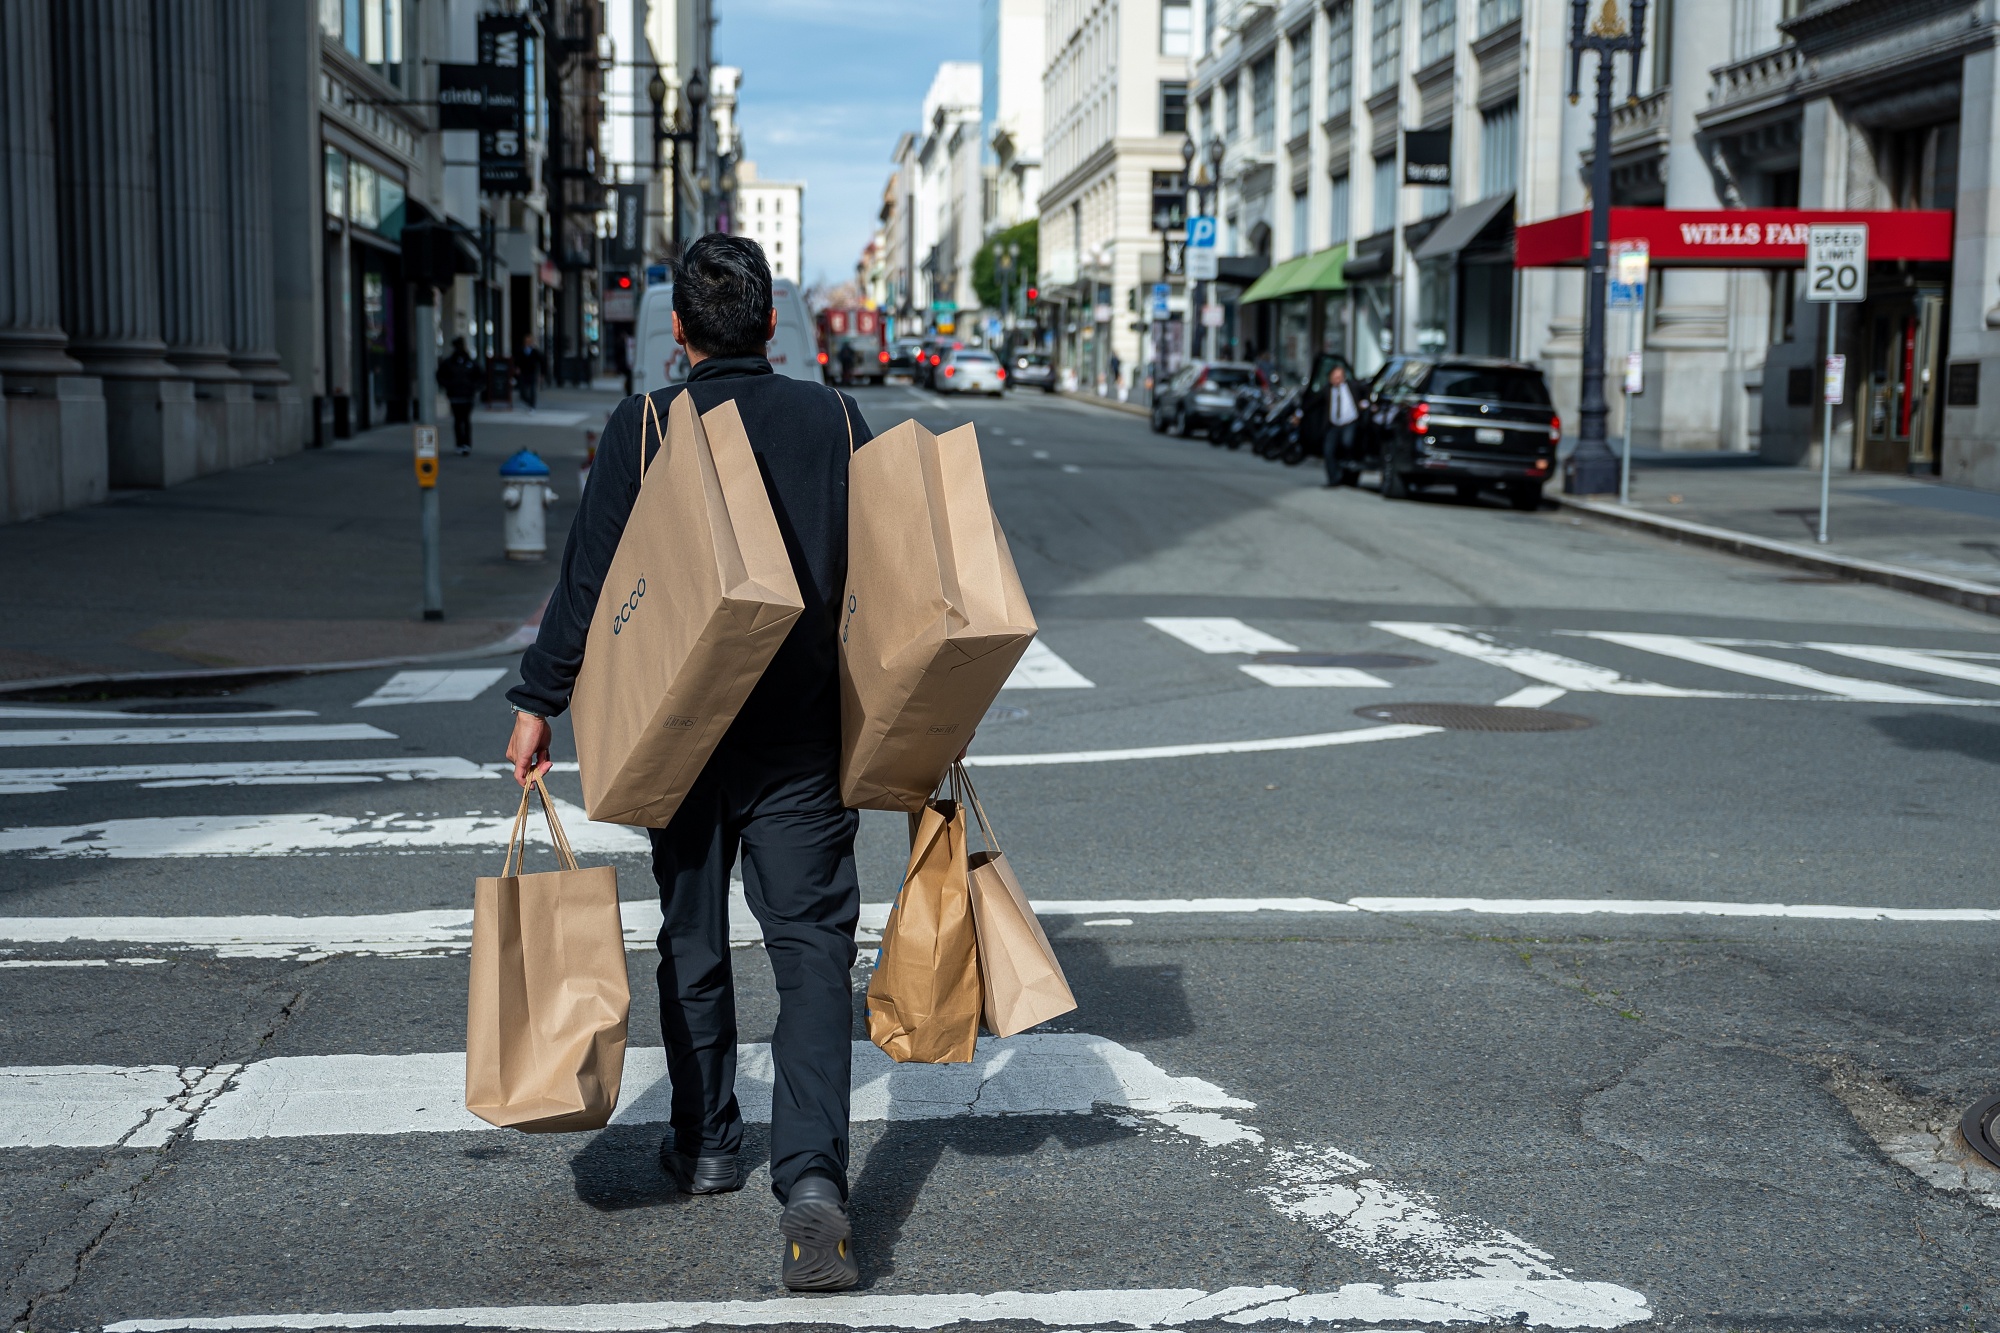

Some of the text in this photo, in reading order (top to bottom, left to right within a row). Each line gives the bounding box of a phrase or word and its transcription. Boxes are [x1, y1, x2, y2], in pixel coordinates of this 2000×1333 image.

[1680, 222, 1809, 246] WELLS FAR
[1814, 231, 1863, 247] SPEED
[1817, 251, 1856, 262] LIMIT
[1814, 264, 1858, 292] 20
[613, 577, 646, 635] ecco
